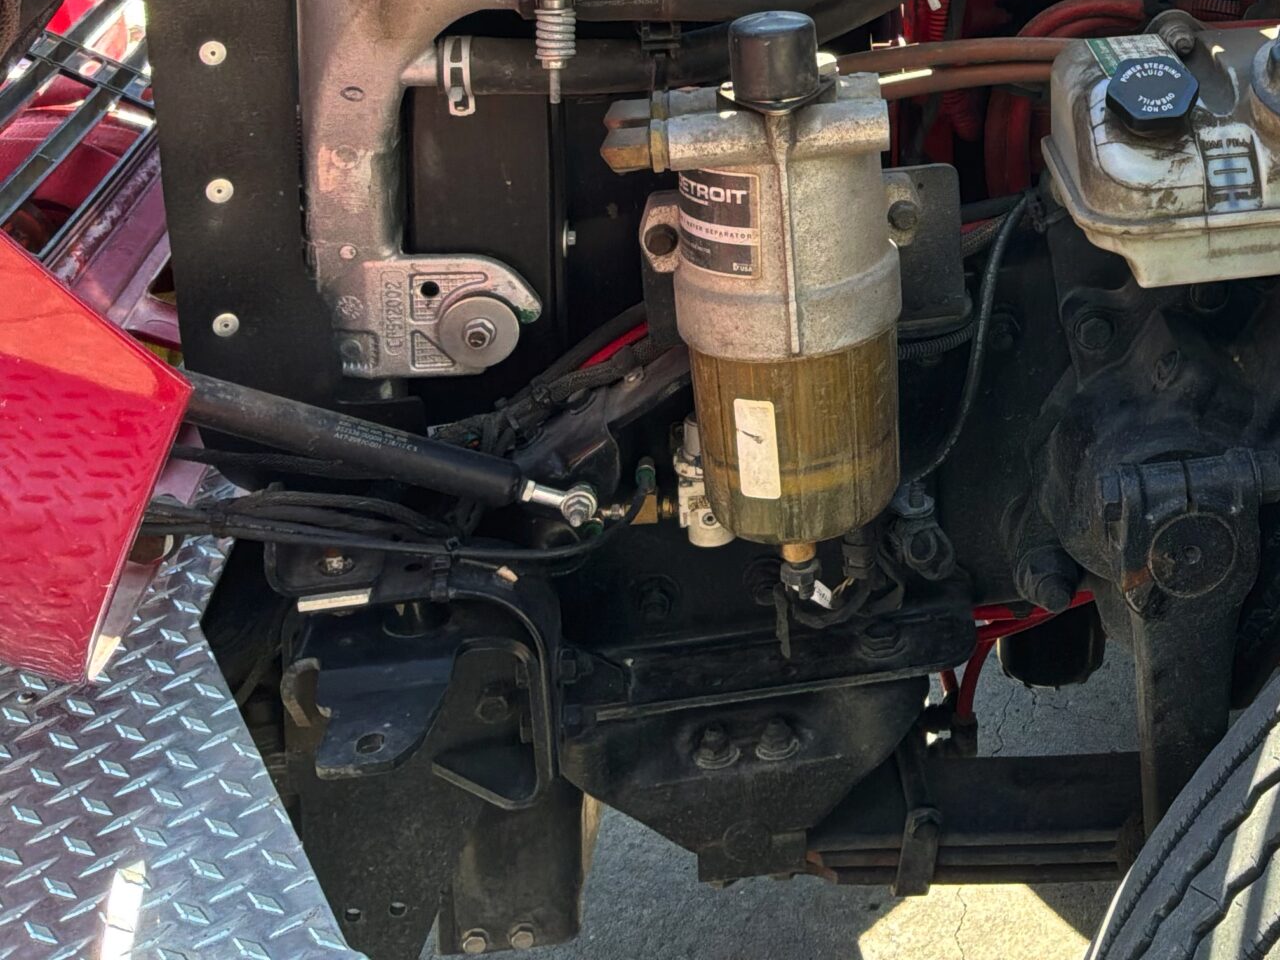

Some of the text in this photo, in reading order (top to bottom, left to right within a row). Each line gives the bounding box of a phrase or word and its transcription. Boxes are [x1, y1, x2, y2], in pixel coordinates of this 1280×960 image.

[1120, 62, 1182, 83] POWER STEERING
[1135, 69, 1164, 79] FLUID
[1137, 92, 1175, 106] OVERFILL
[1161, 103, 1174, 112] DO
[704, 228, 752, 239] SEPARATOR
